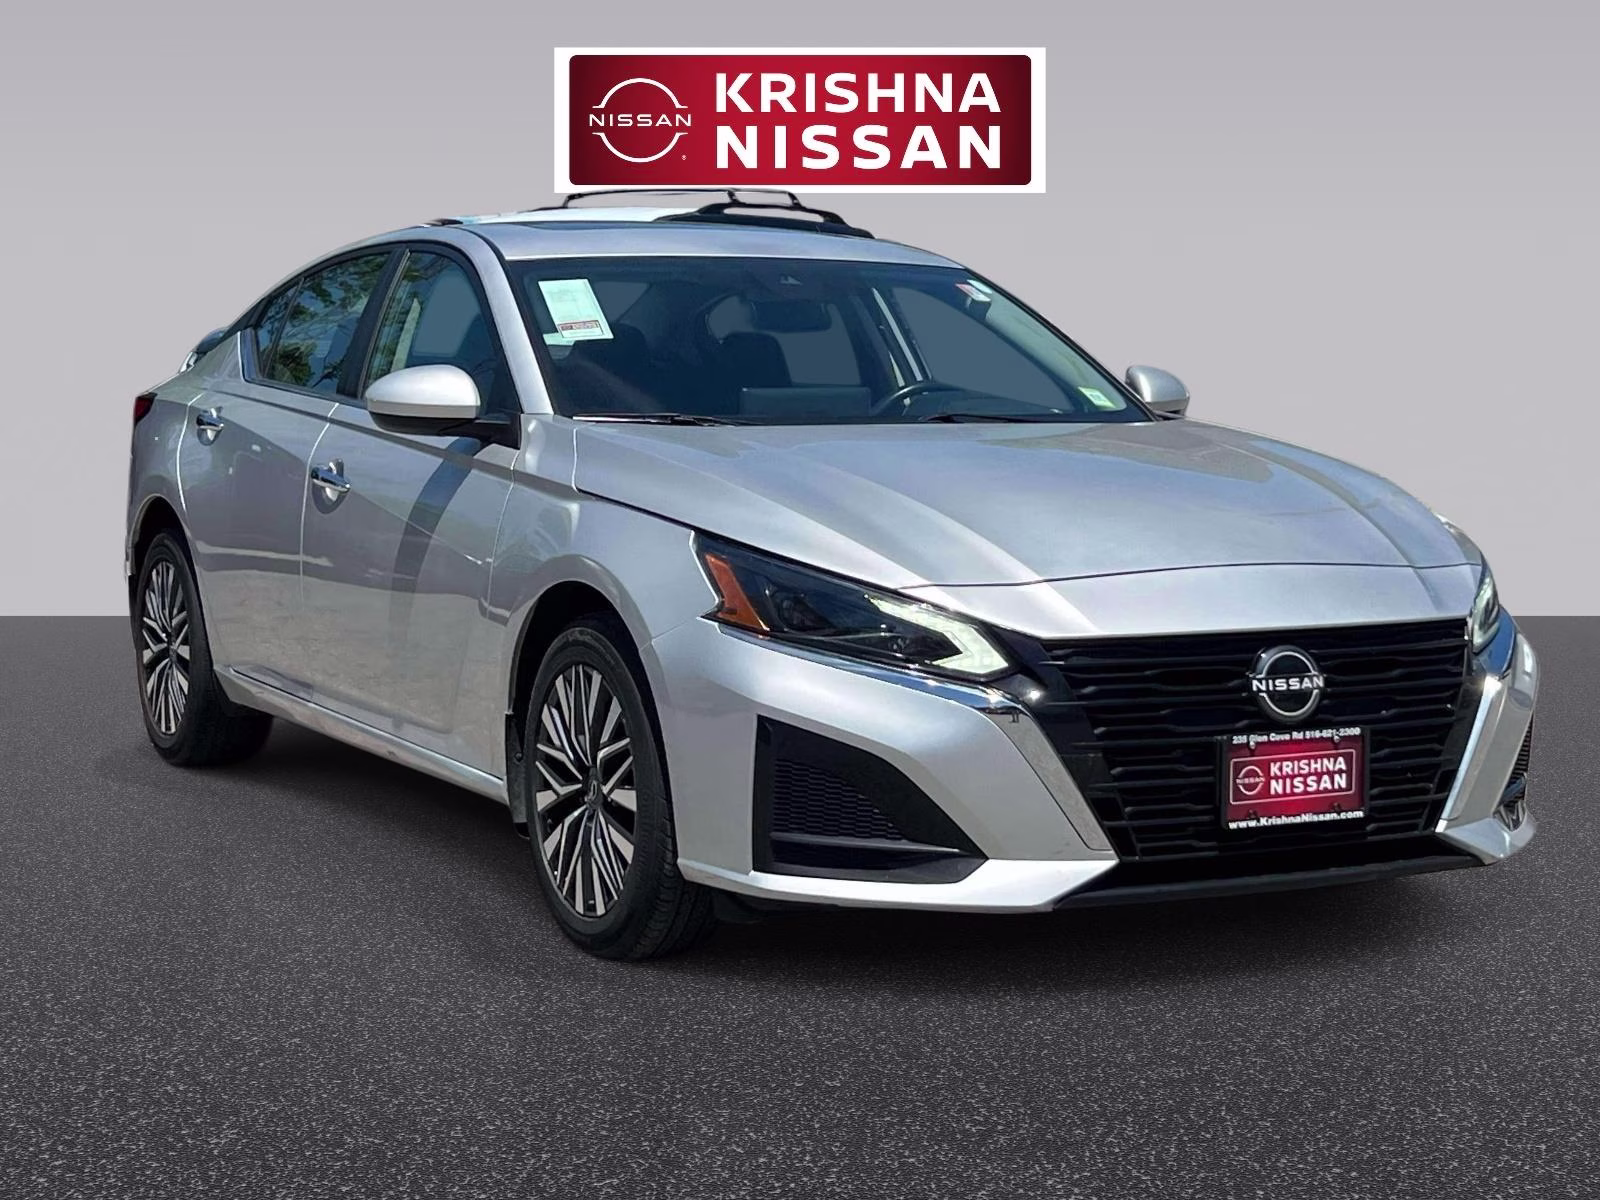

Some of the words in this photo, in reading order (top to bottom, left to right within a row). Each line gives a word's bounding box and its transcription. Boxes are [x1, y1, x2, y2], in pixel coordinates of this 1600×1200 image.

[1252, 677, 1324, 691] NISSAN
[1269, 733, 1291, 742] Cove
[1291, 731, 1304, 740] Rd
[1270, 756, 1346, 776] KRISHNA
[1270, 773, 1346, 794] NISSAN
[1228, 811, 1364, 829] www.KrishnaNissan.com
